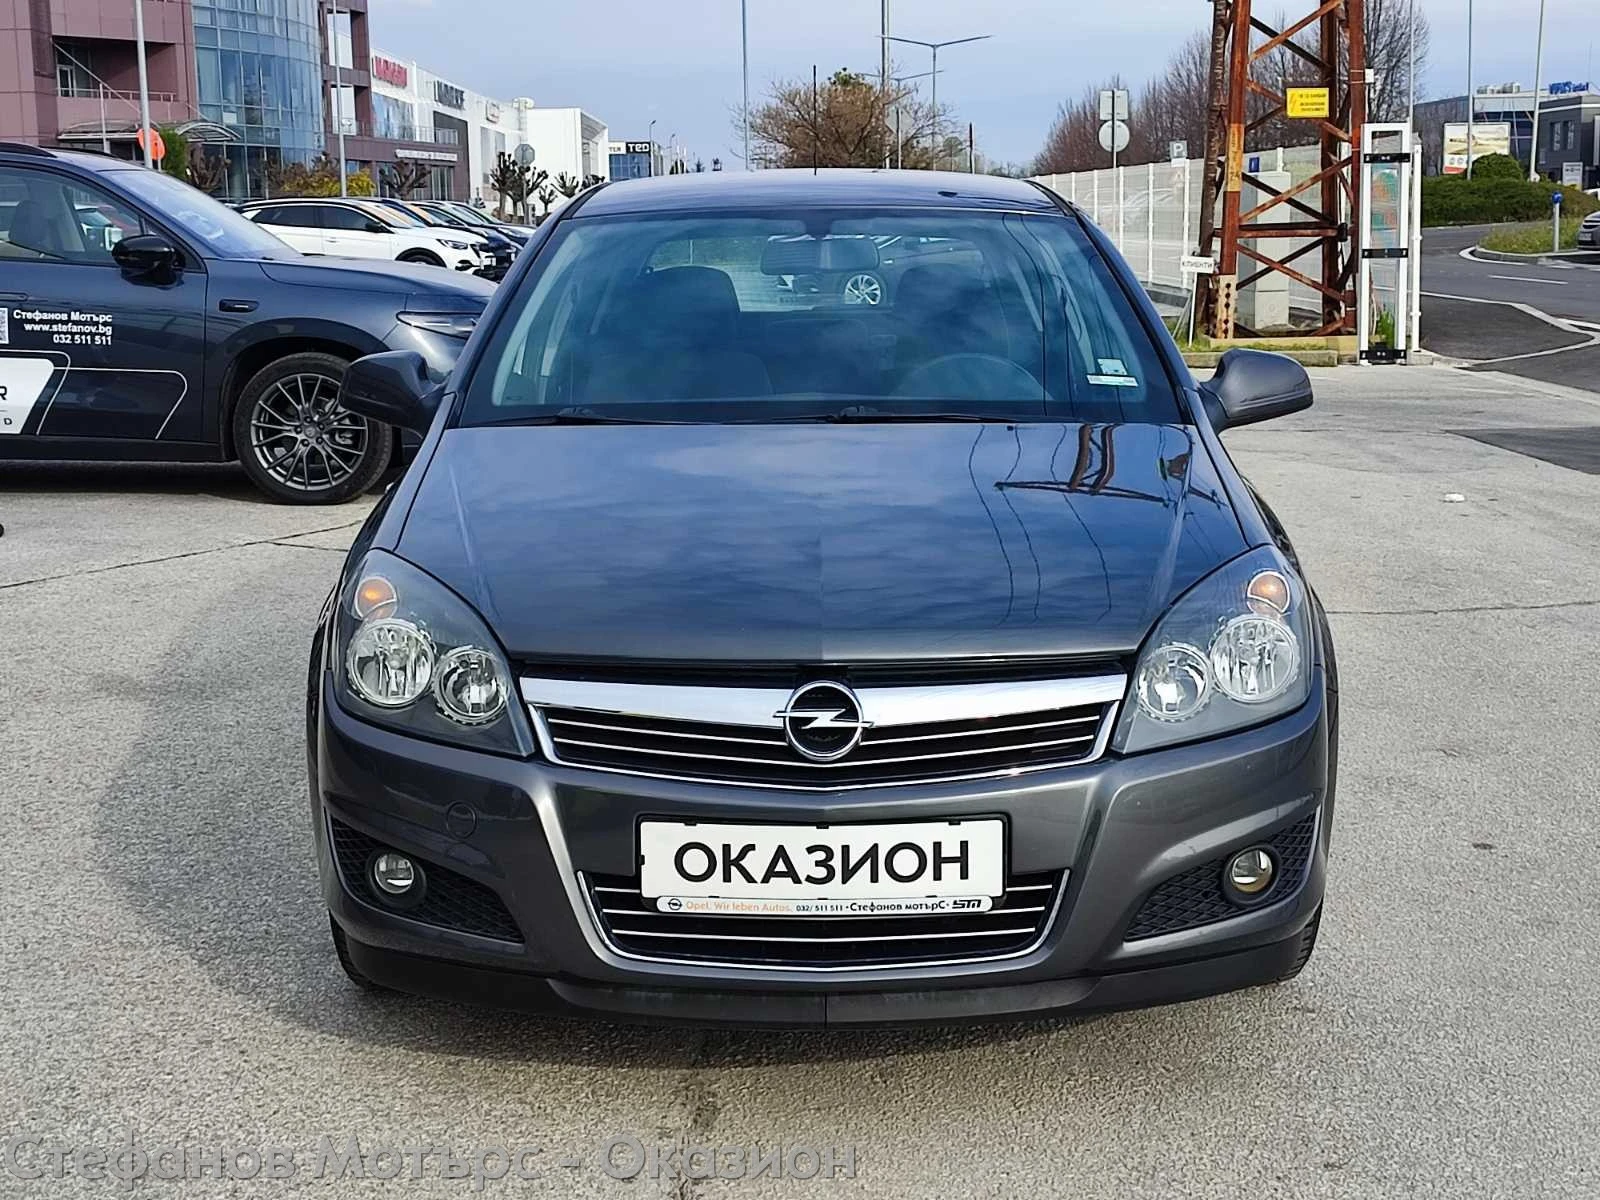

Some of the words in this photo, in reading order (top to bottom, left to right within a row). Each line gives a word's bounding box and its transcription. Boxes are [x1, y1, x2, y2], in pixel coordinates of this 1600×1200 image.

[13, 309, 68, 322] Стефанов
[70, 311, 112, 323] Мотърс
[23, 322, 112, 335] www.stefanov.bg
[52, 333, 72, 344] 032
[74, 334, 92, 345] 511
[94, 335, 112, 345] 511
[673, 840, 970, 885] ОКАЗИОН
[686, 900, 710, 912] Opel.
[713, 901, 731, 910] Wir
[732, 901, 760, 911] leben
[761, 902, 793, 912] Autos.
[815, 904, 828, 912] 511
[830, 904, 843, 912] 511
